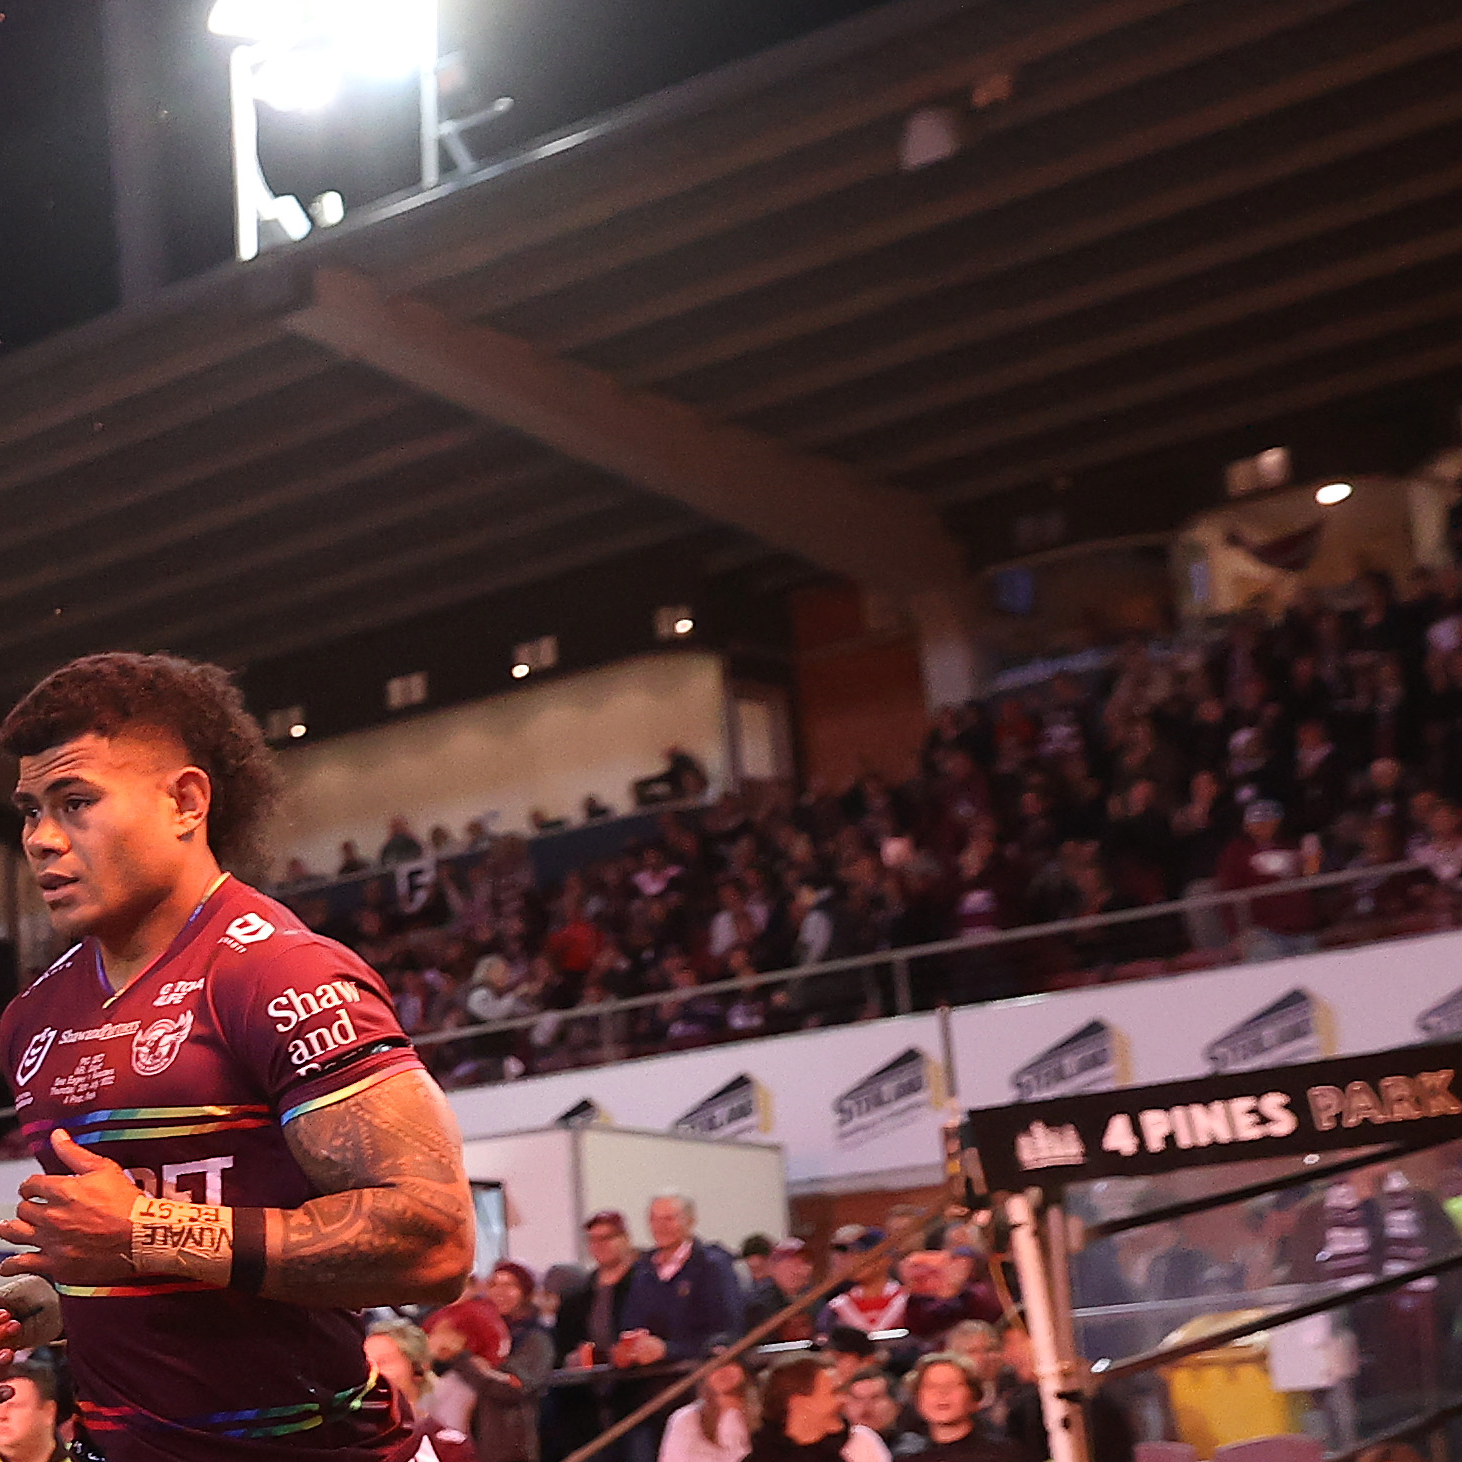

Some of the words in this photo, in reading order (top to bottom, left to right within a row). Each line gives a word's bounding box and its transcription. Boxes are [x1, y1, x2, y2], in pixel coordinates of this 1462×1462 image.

[267, 980, 361, 1033] Shaw
[288, 1008, 358, 1065] and
[1101, 1112, 1139, 1157] 4
[1139, 1091, 1299, 1154] PINES
[1306, 1068, 1462, 1132] PARK
